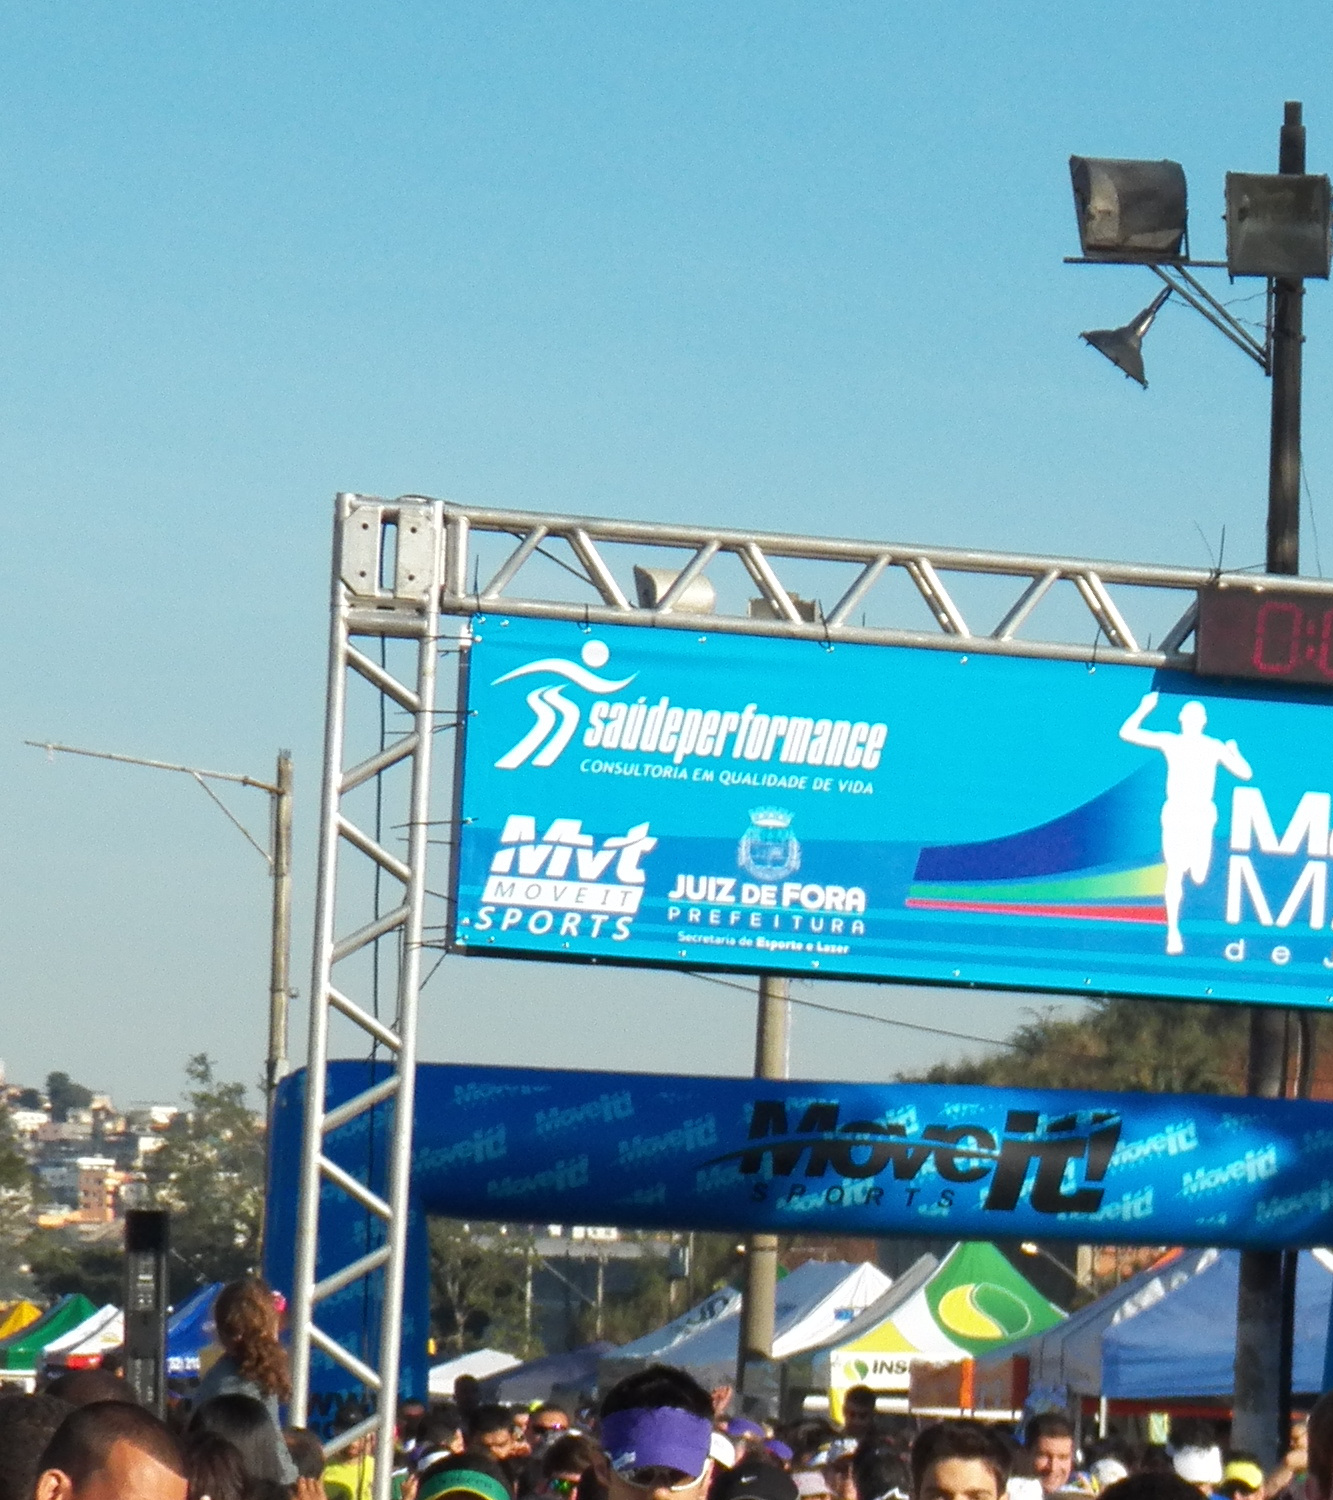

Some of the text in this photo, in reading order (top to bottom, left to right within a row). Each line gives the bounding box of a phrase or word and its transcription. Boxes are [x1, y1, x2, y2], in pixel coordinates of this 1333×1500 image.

[584, 695, 888, 771] saúdeperformance
[580, 758, 874, 794] CONSULTORIA EM QUALIDADE DE VIDA
[667, 873, 867, 912] JUIZ DE FORA
[474, 906, 634, 941] SPORTS
[667, 905, 866, 935] PREFEITURA
[677, 930, 736, 947] Secretaria
[738, 934, 754, 947] de
[755, 935, 805, 952] Esporte
[816, 941, 850, 955] Lazer
[753, 1181, 956, 1209] SPORTS
